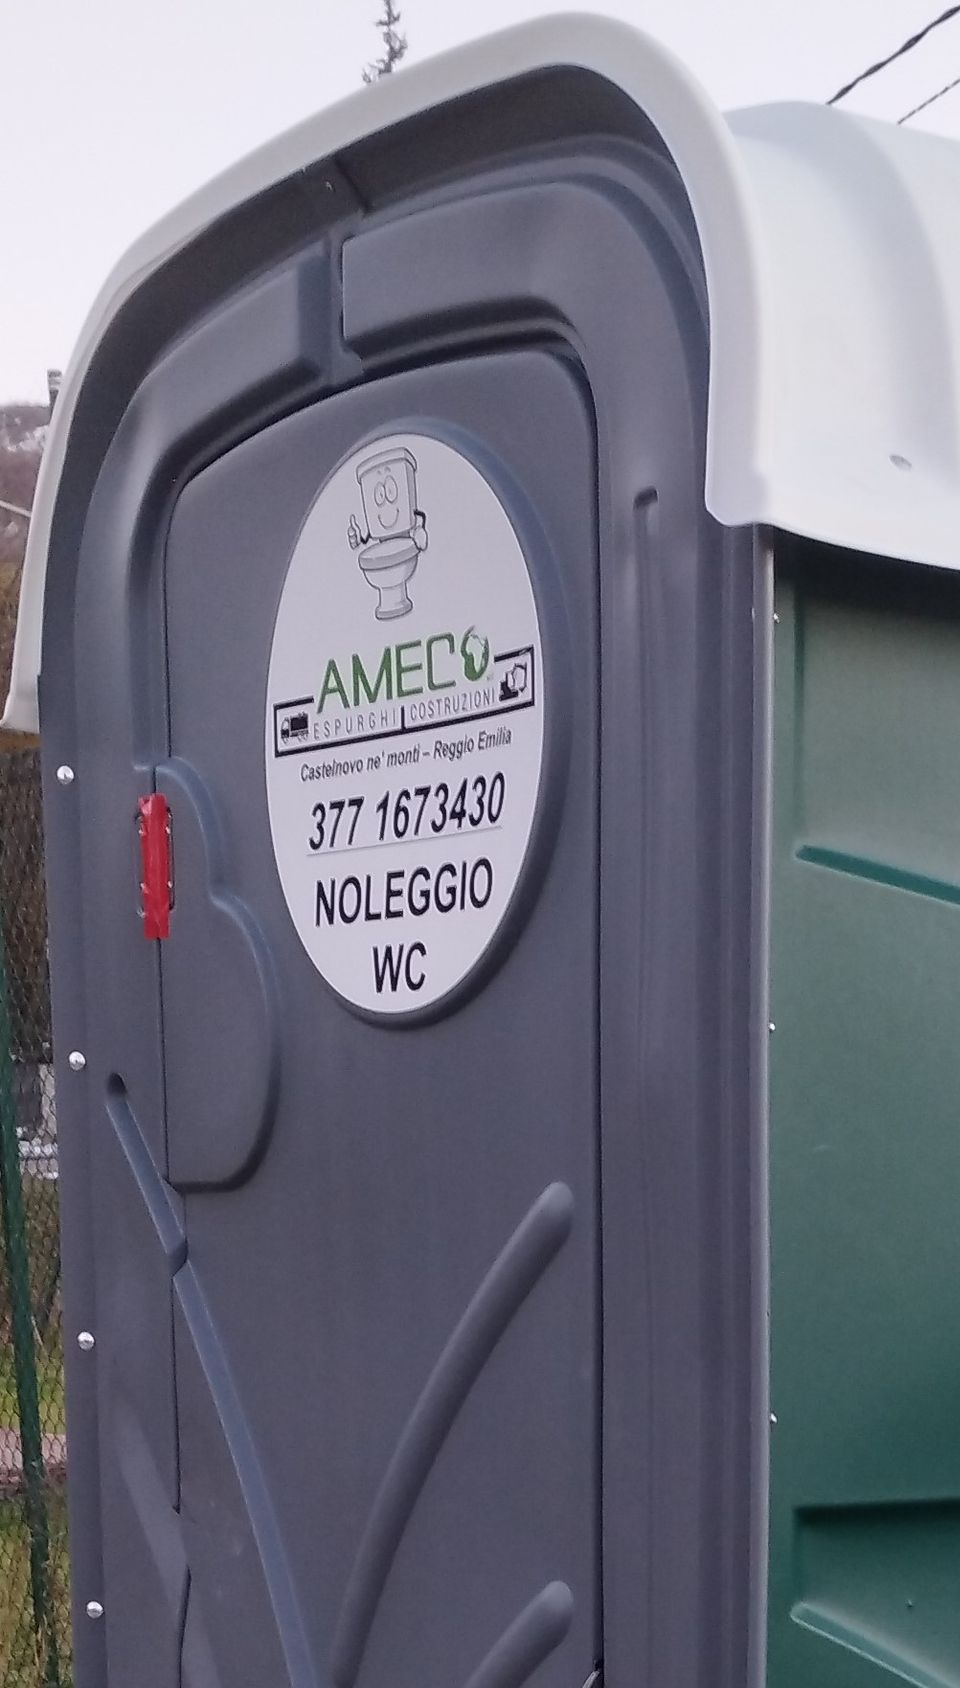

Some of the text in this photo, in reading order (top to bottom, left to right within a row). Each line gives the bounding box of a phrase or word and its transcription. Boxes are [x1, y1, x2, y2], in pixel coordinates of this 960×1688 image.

[313, 687, 496, 741] ESPURGHI COSTRUZIONI
[301, 754, 364, 782] Castelnovo
[386, 742, 420, 766] monti
[433, 737, 475, 762] Reggio
[478, 725, 513, 751] Emilia
[309, 771, 506, 851] 377 1673430
[314, 856, 494, 927] NOLEGGIO
[372, 941, 427, 994] WC
